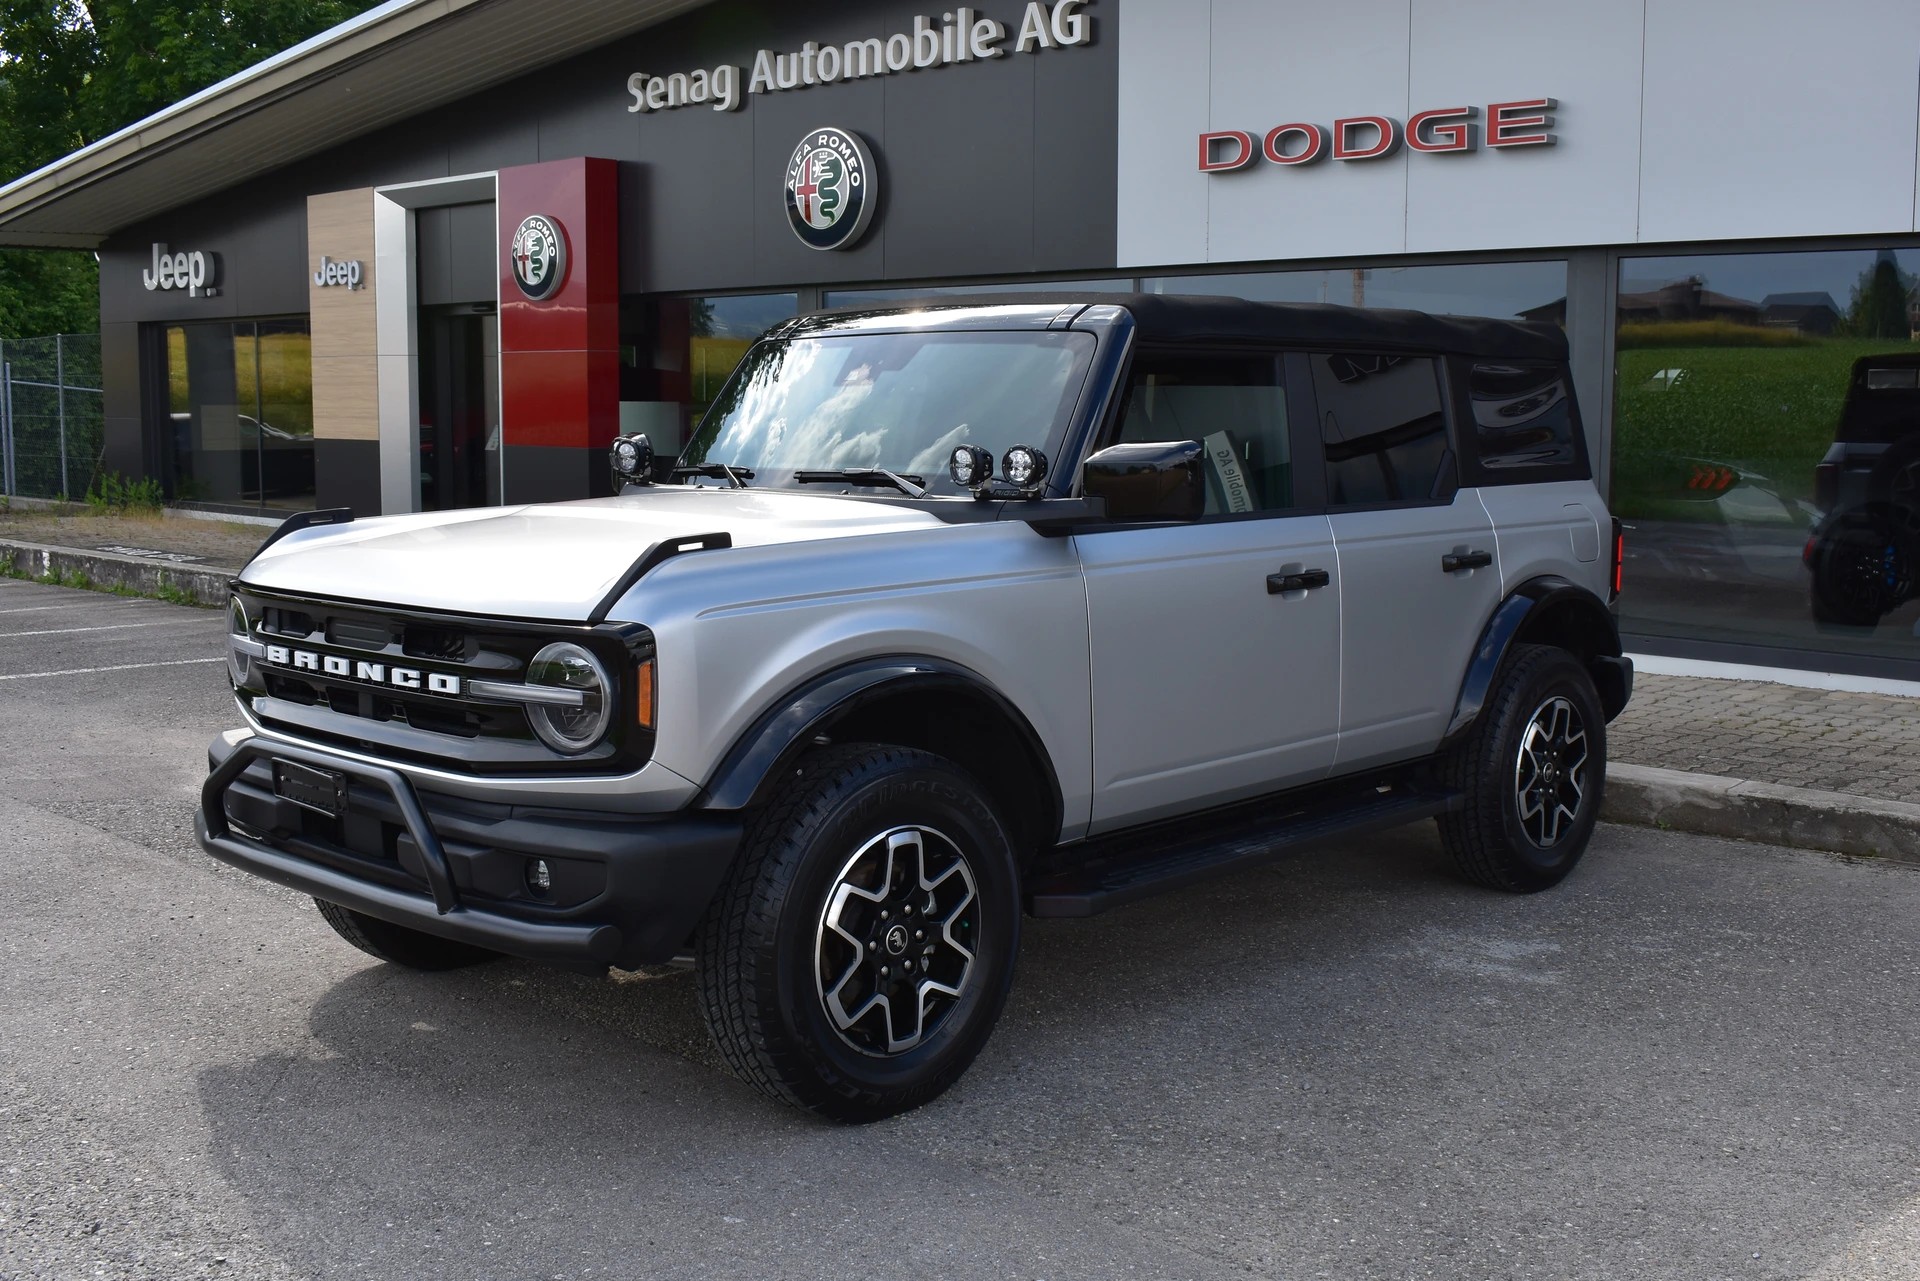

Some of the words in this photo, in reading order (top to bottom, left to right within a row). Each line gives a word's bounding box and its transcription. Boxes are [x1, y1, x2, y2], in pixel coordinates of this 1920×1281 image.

[627, 64, 740, 112] Senag
[748, 7, 1004, 94] Automobile
[1015, 0, 1091, 53] AG
[788, 143, 812, 192] ALFA
[818, 134, 861, 187] ROMEO
[1198, 98, 1557, 174] DODGE
[529, 219, 556, 257] ROMEO
[143, 243, 215, 298] Jeep
[314, 255, 363, 290] Jeep
[266, 645, 460, 695] BRONCO
